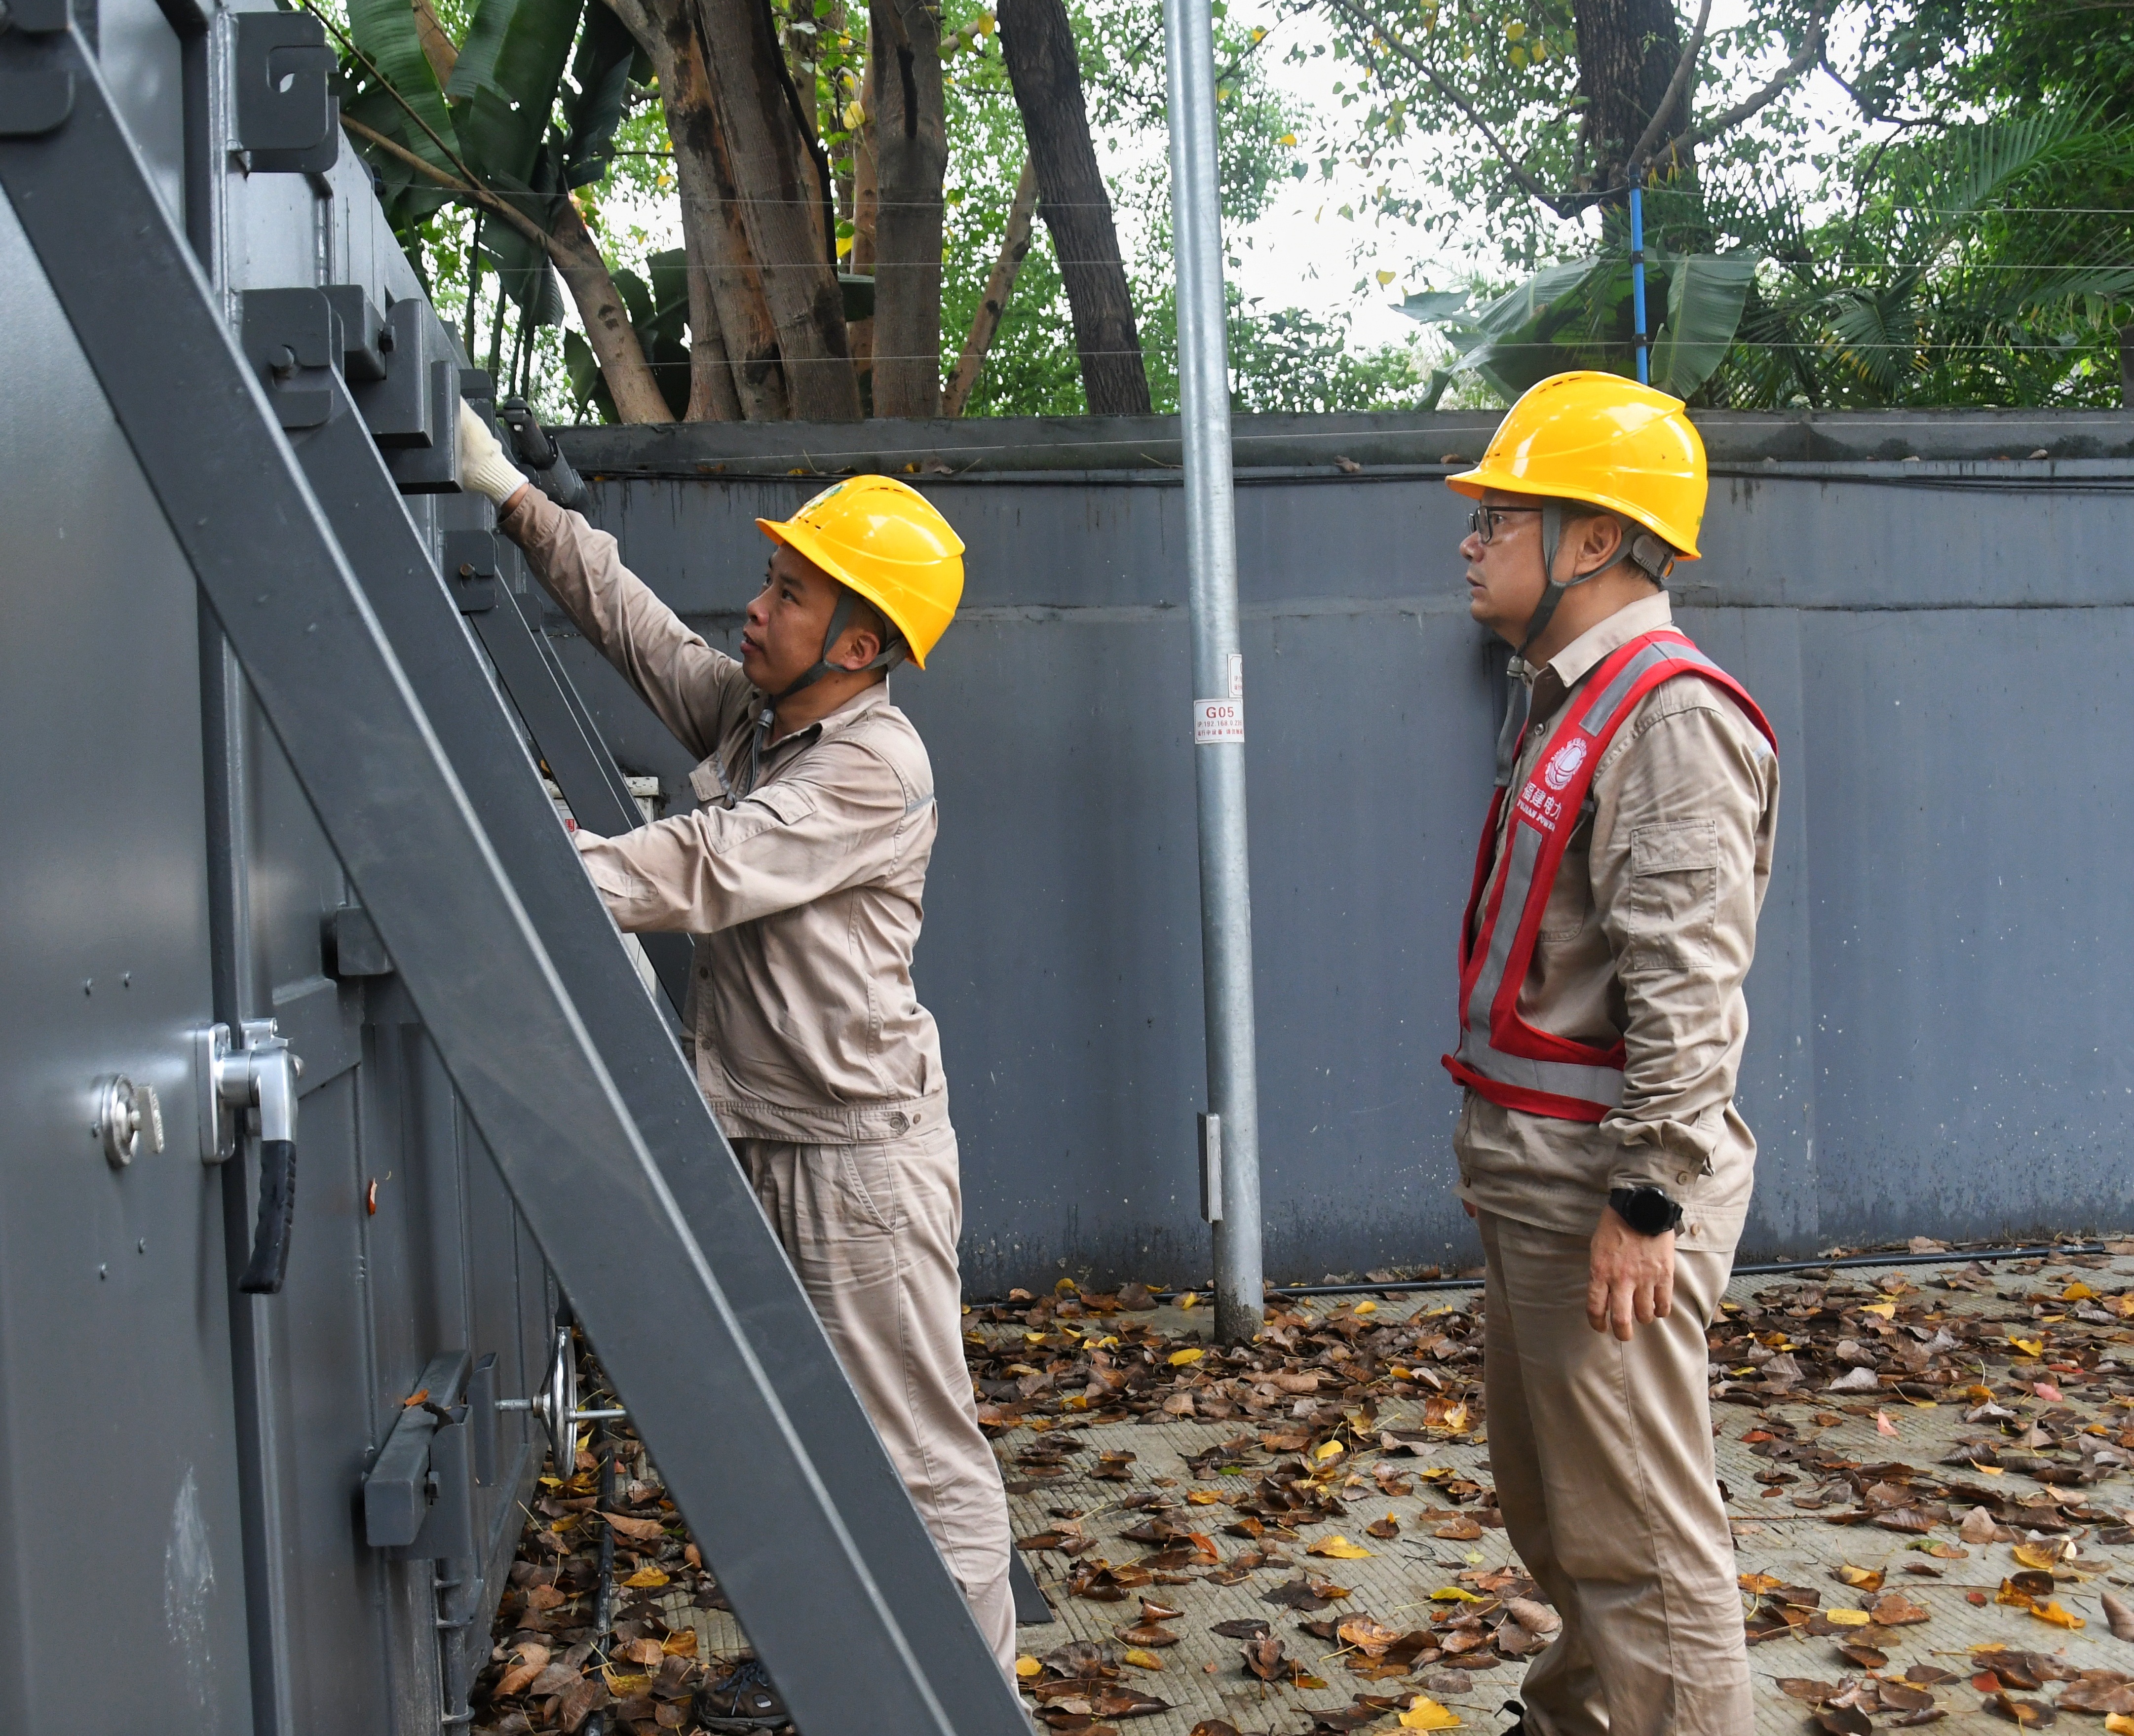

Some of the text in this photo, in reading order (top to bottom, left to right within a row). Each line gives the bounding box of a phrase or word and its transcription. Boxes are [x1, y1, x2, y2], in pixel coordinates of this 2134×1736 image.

[1206, 706, 1234, 718] G05
[1517, 798, 1556, 833] FUJIAN POWER
[1522, 781, 1562, 820] 福建电力
